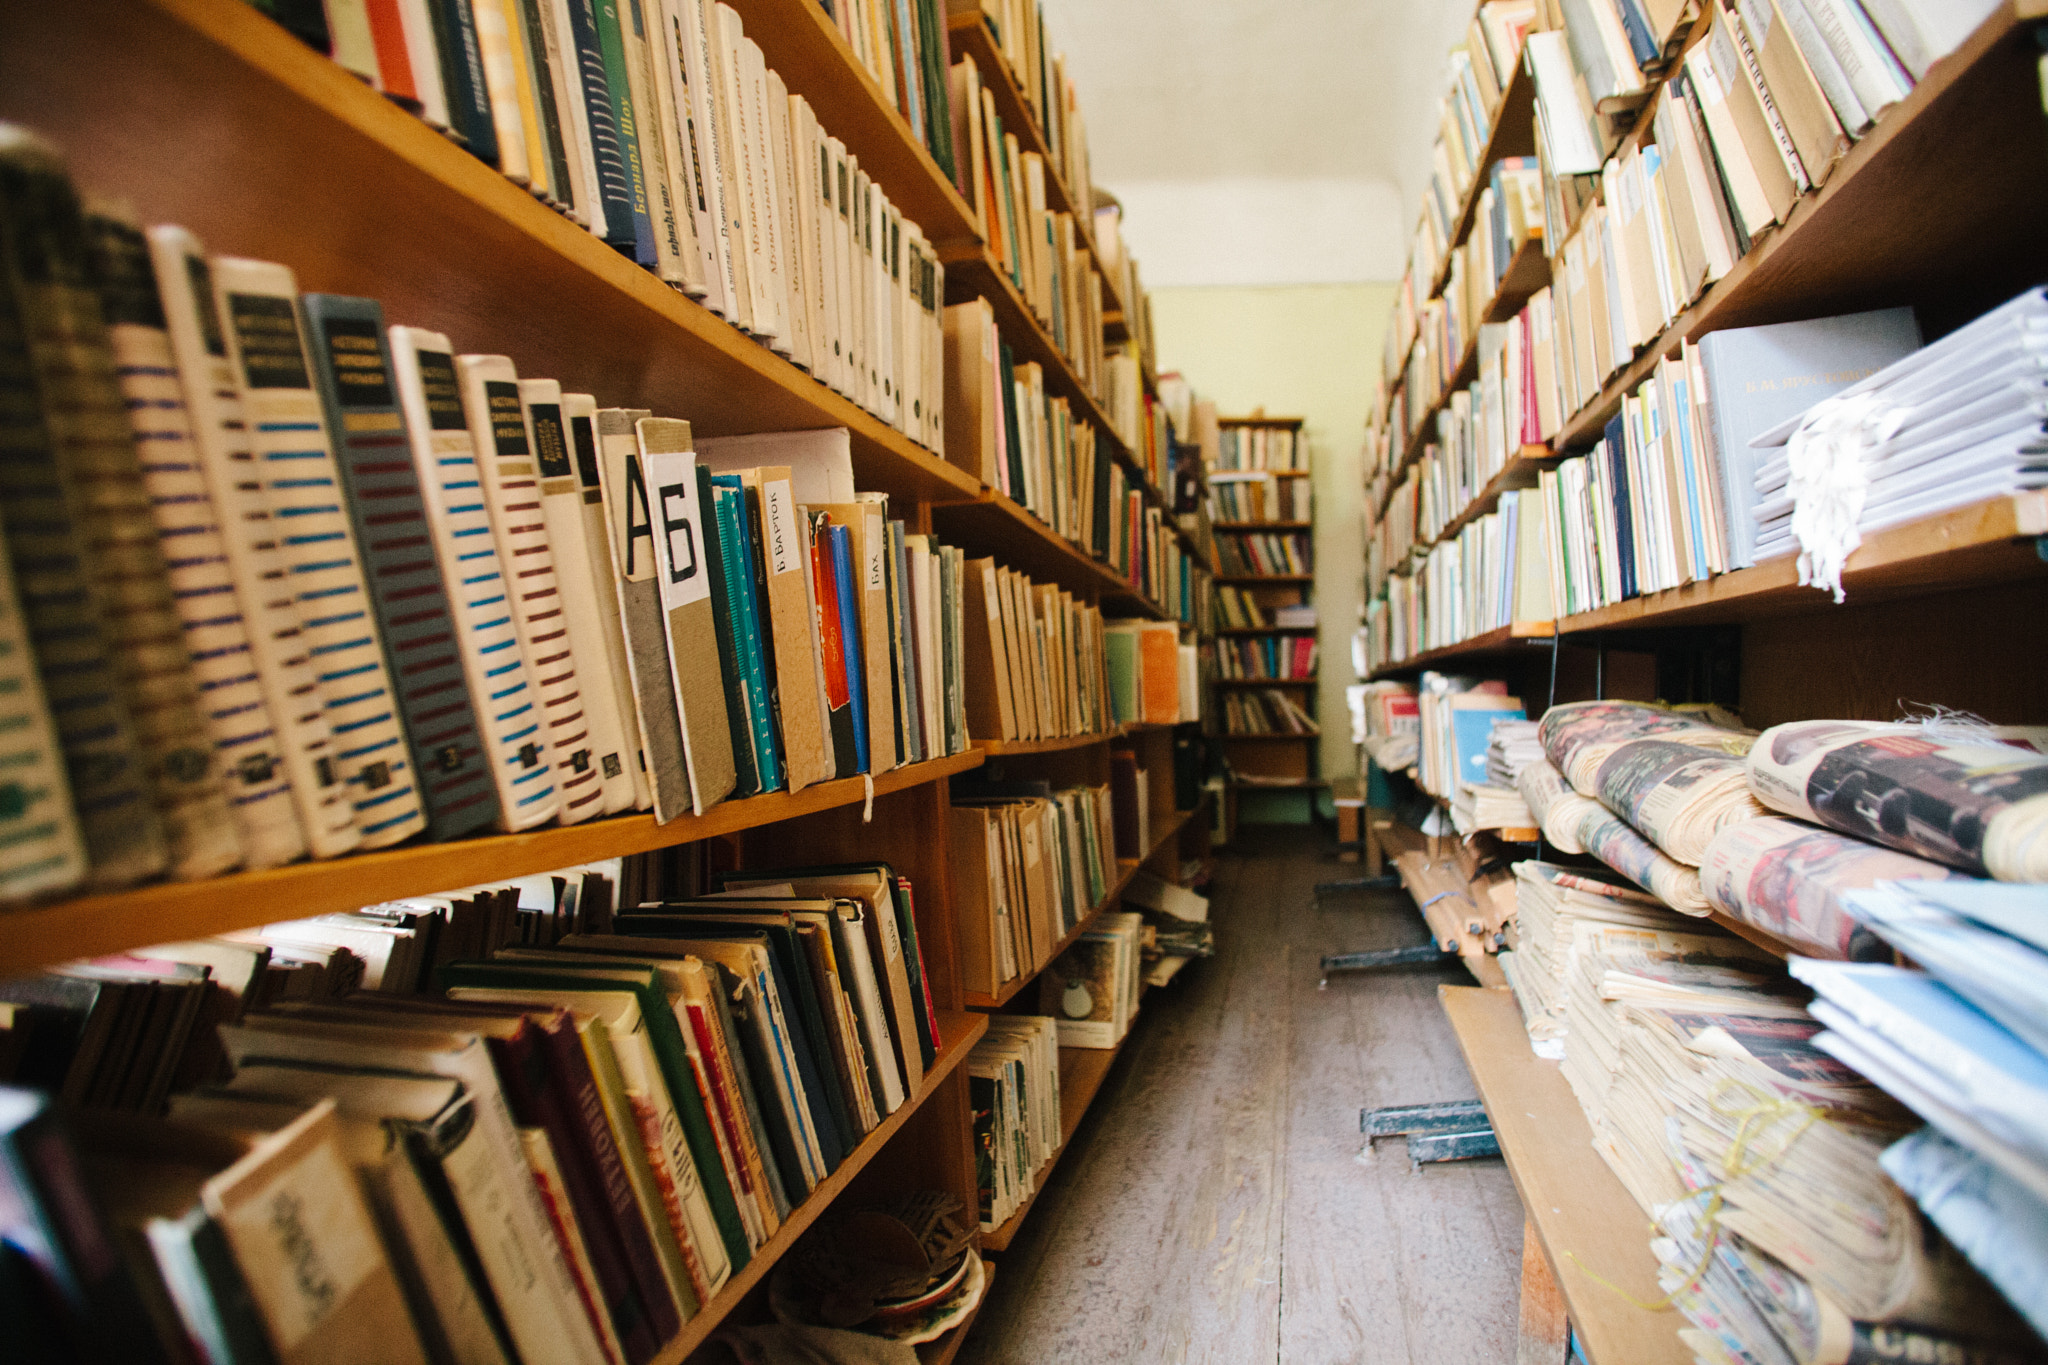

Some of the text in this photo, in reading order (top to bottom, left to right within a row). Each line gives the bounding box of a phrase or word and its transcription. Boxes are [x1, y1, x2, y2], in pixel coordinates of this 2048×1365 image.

[619, 96, 647, 214] Бернард Шоу
[659, 483, 698, 584] Б
[770, 492, 784, 556] БАРТОК
[871, 553, 880, 585] БАХ
